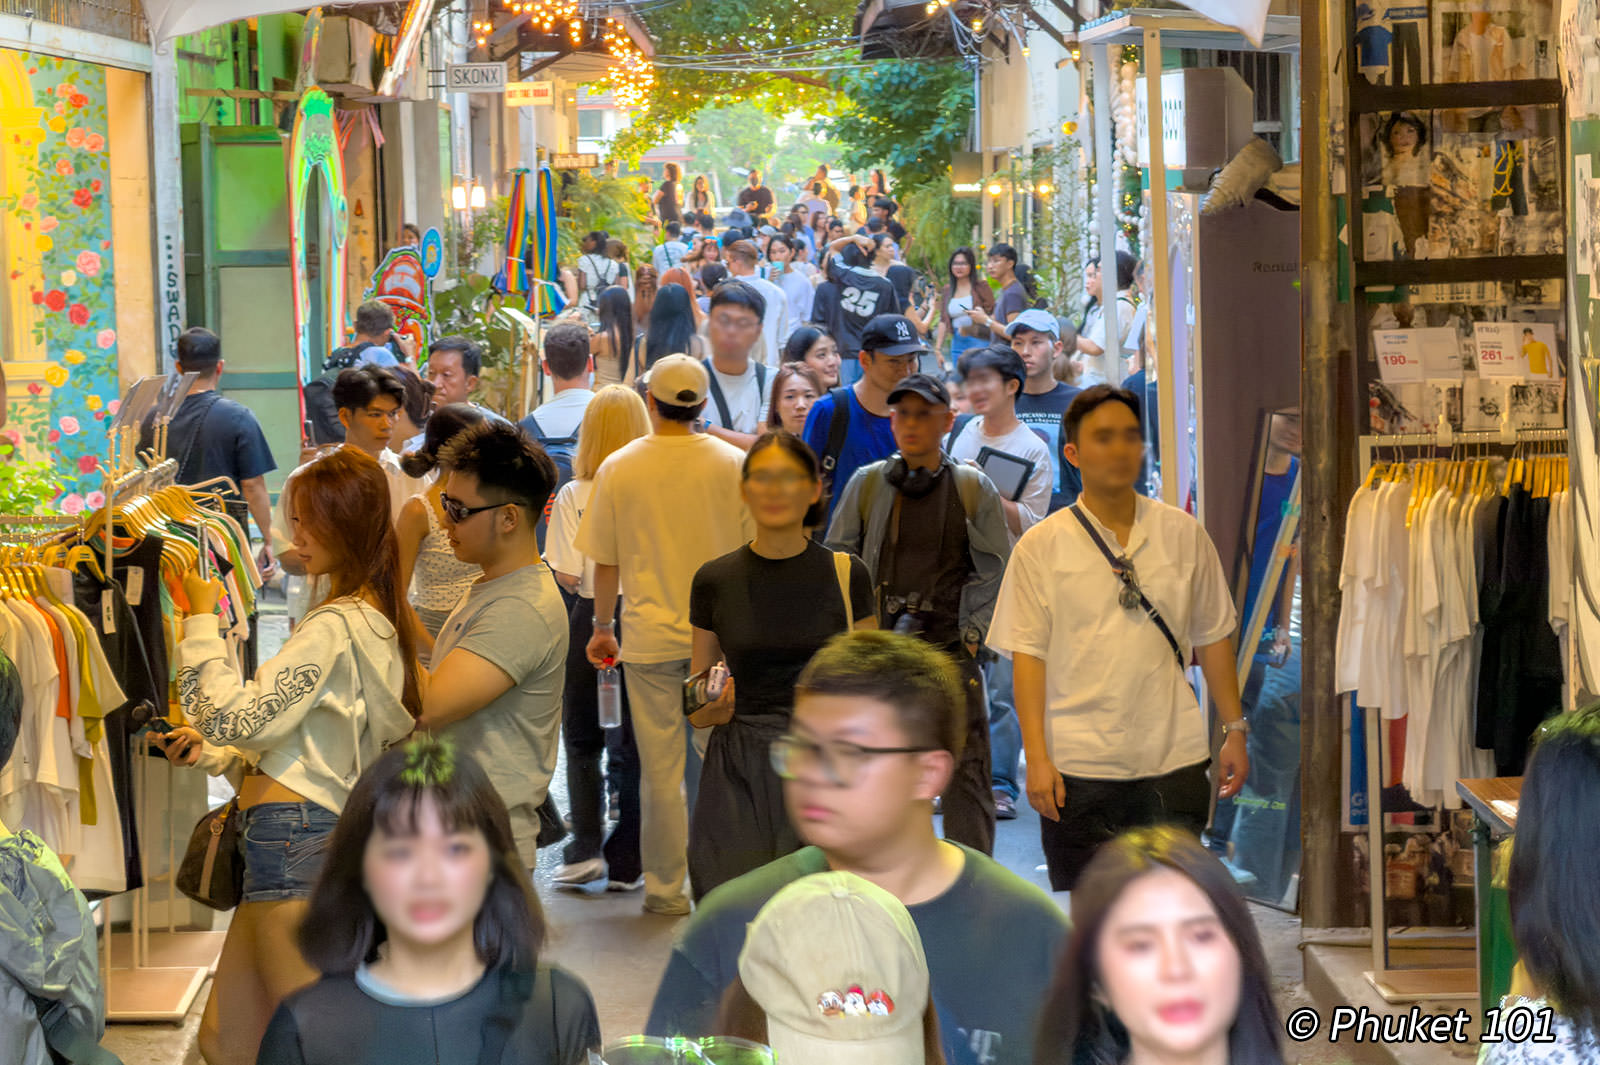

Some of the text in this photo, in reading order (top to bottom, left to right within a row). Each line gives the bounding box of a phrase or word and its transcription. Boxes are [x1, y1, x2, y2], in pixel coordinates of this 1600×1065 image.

[454, 68, 498, 84] SKONX
[840, 286, 880, 317] 25
[1383, 355, 1407, 366] 190
[1481, 350, 1503, 361] 261
